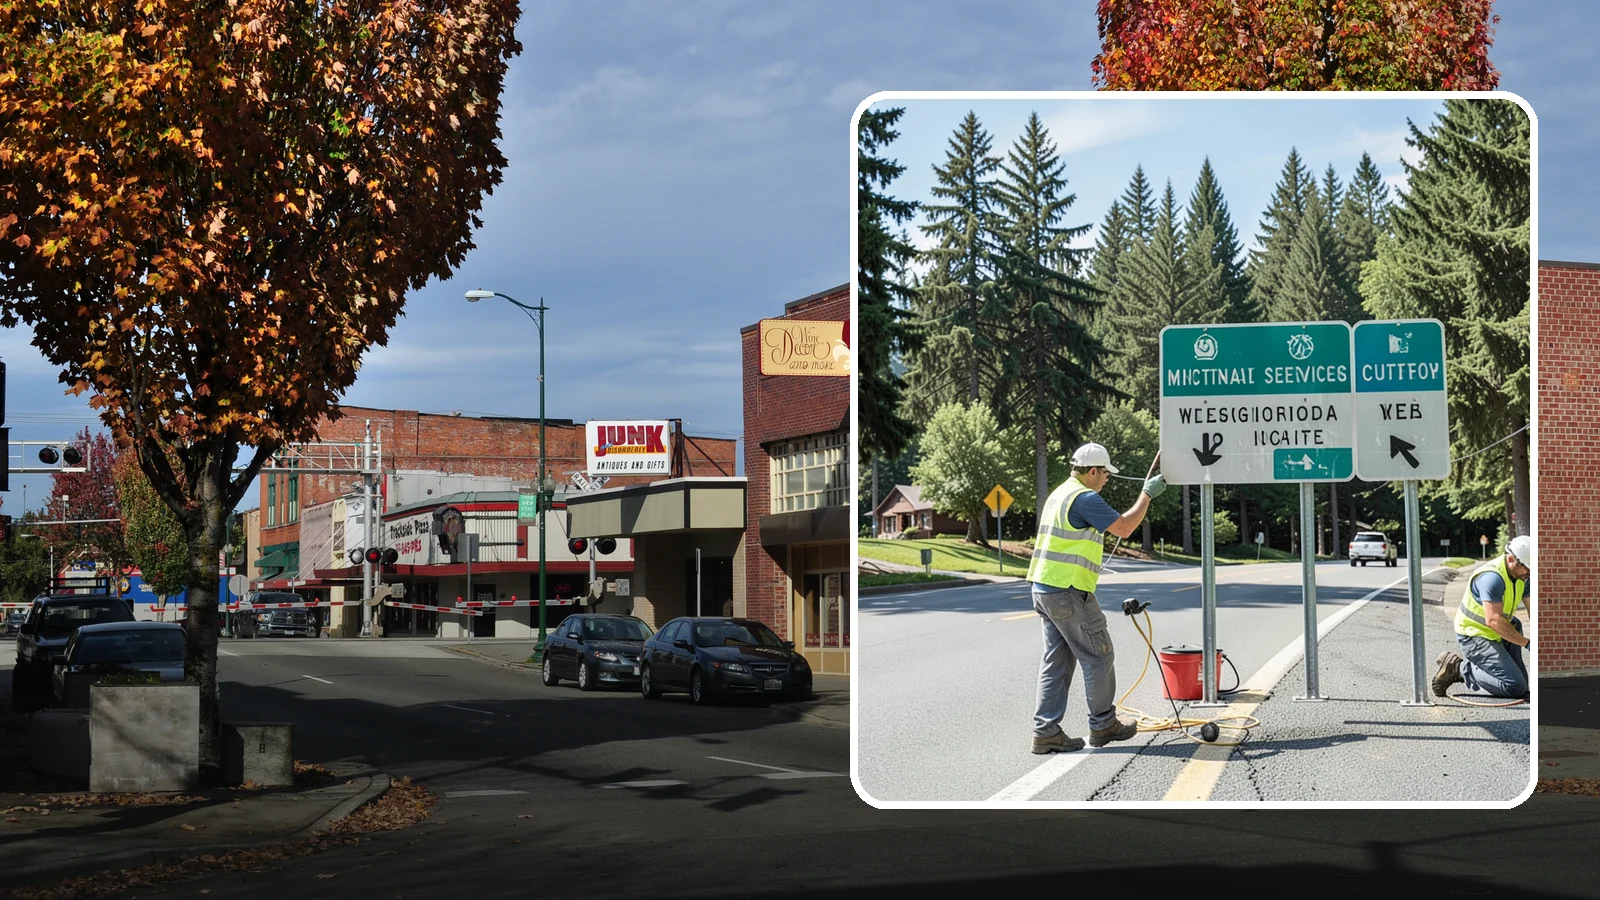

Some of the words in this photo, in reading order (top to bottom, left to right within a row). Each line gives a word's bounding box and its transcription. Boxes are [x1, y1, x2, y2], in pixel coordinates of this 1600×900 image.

[595, 425, 665, 457] JUNK
[607, 446, 645, 454] DISORDERLY
[597, 461, 628, 470] ANTIQUES
[631, 461, 644, 470] AND
[647, 460, 665, 470] GIFTS
[590, 475, 608, 491] SING
[414, 519, 429, 535] Pizza
